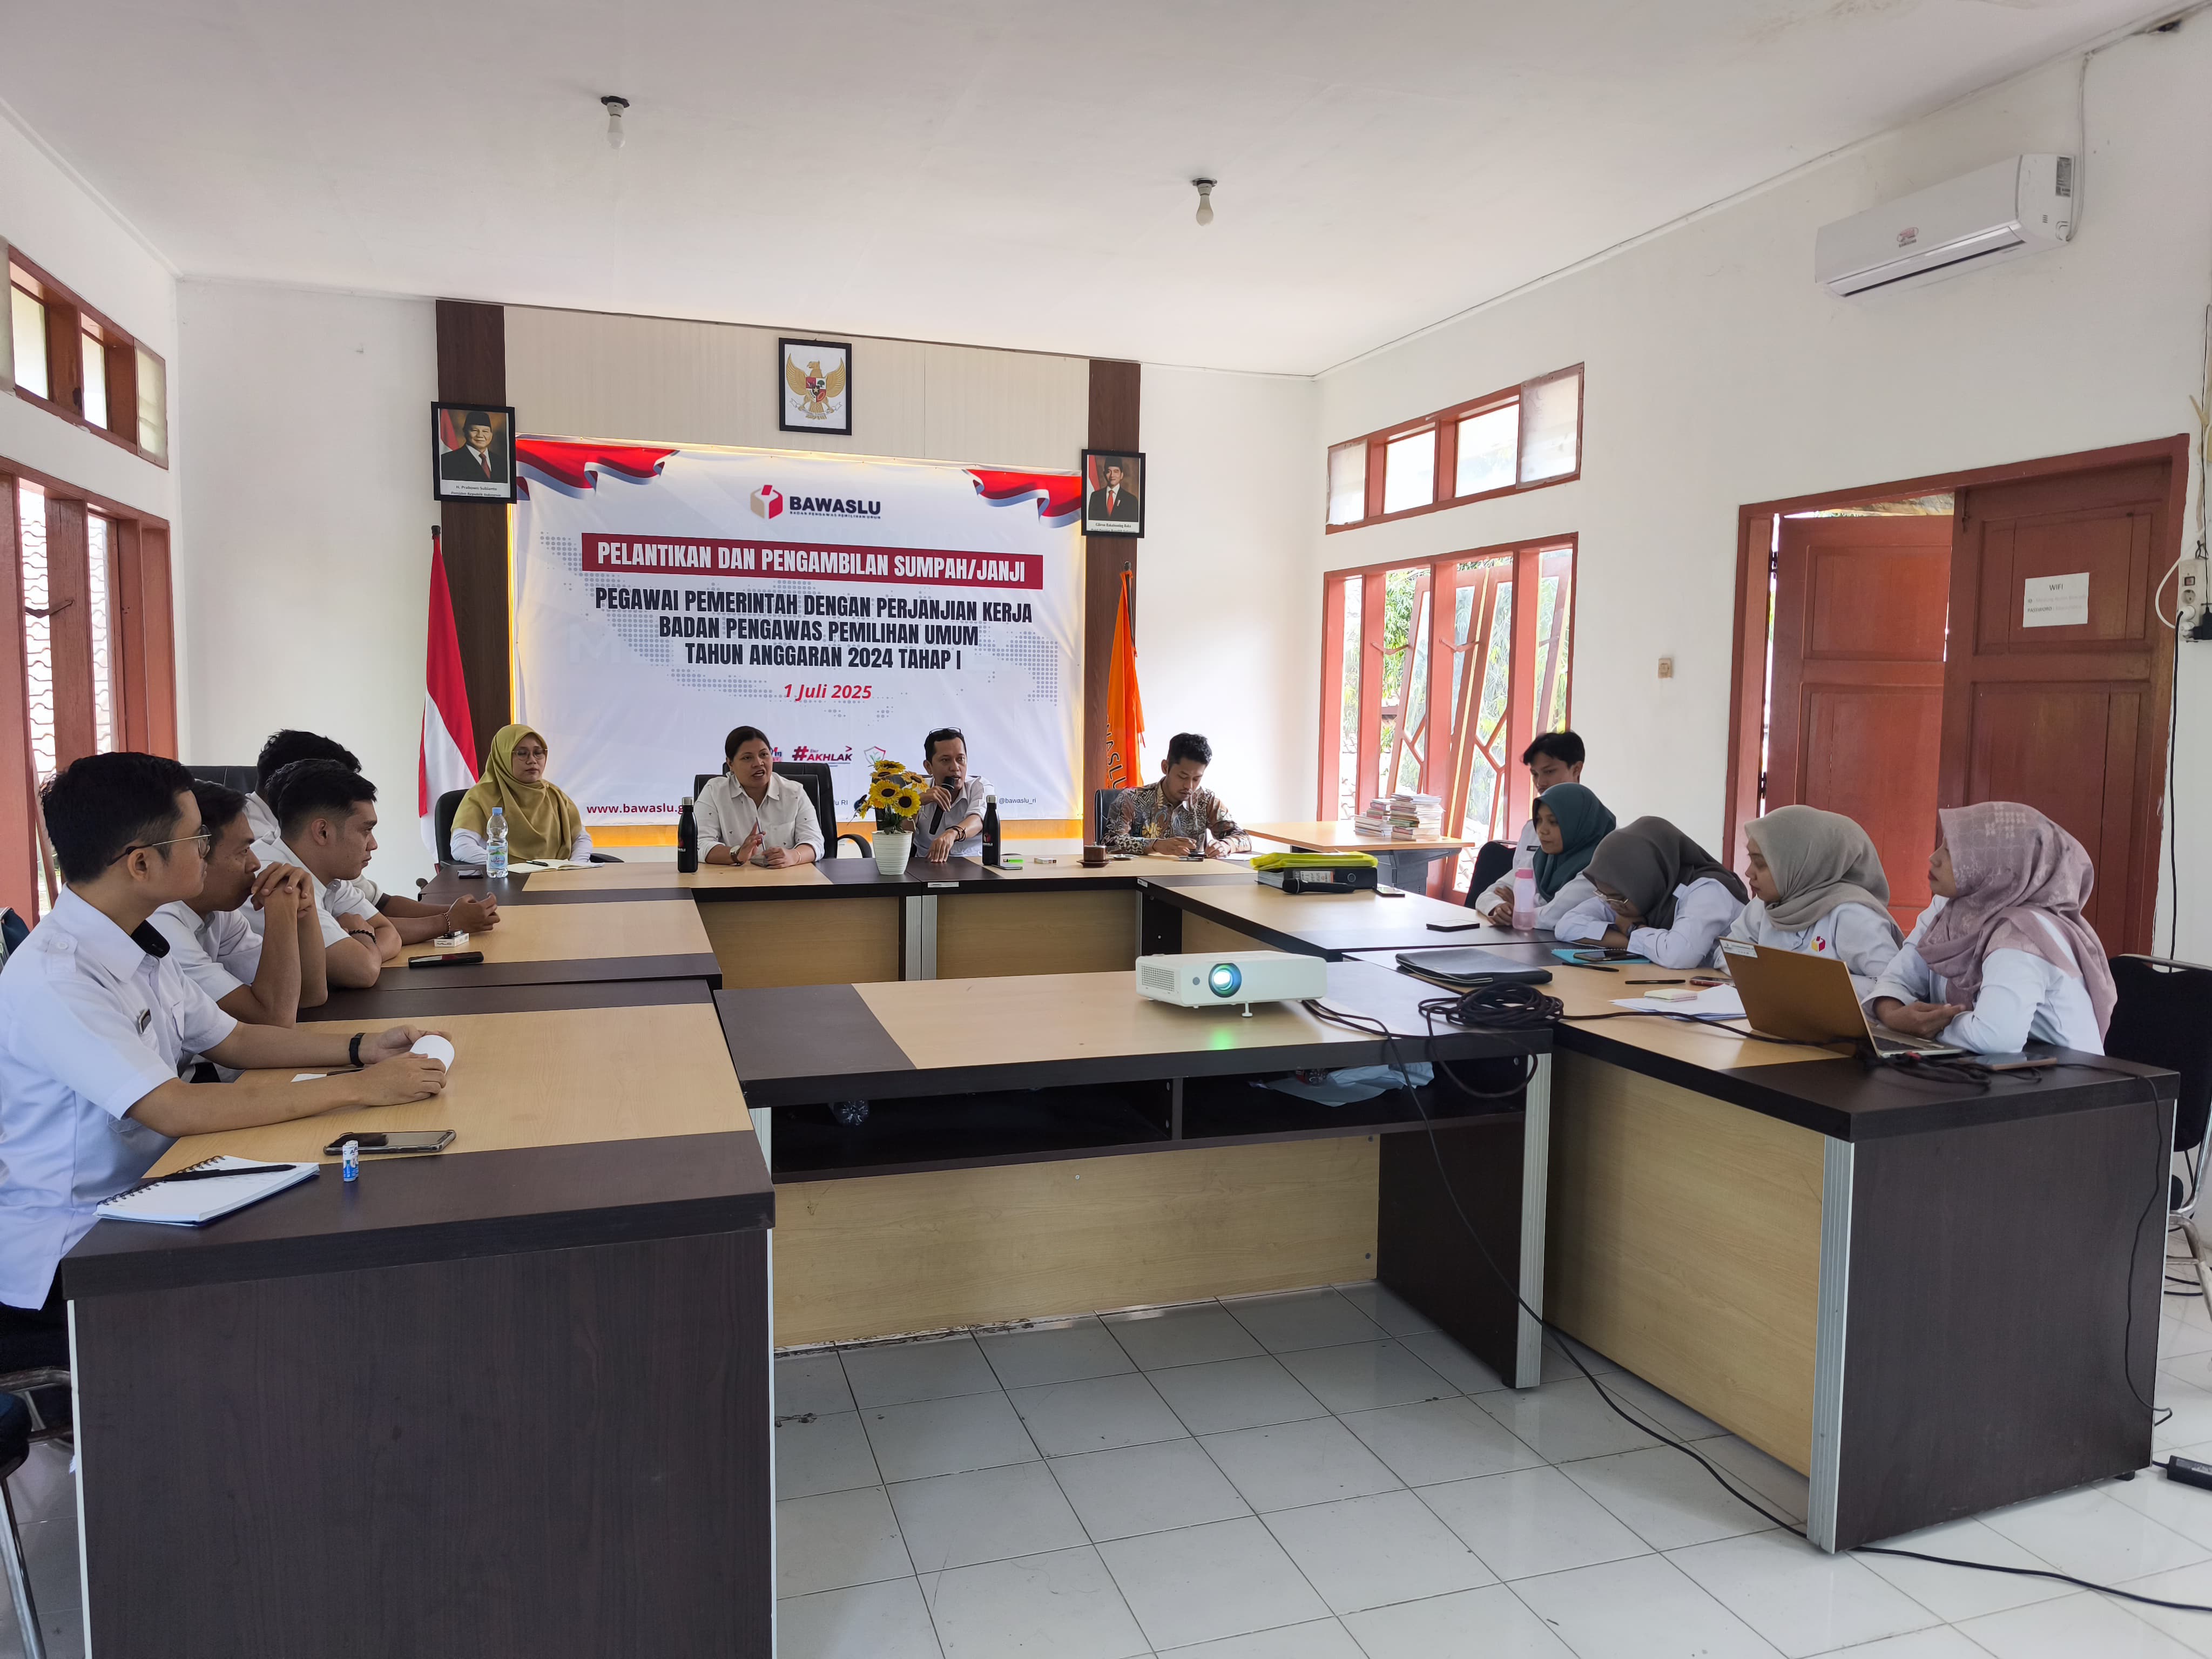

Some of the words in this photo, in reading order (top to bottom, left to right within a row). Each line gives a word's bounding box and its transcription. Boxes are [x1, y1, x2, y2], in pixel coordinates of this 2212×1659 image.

[790, 496, 881, 515] BAWASLU
[598, 542, 711, 568] PELANTIKAN
[718, 547, 755, 570] DAN
[761, 549, 888, 576] PENGAMBILAN
[894, 555, 1025, 582] SUMPAH/JANJI
[596, 588, 678, 611] PEGAWAI
[685, 591, 798, 615] PEMERINTAH
[804, 595, 870, 617] DENGAN
[877, 597, 977, 621] PERJANJIAN
[983, 602, 1032, 623] KERJA
[659, 616, 719, 638] BADAN
[726, 618, 822, 642] PENGAWAS
[829, 621, 919, 644] PEMILIHAN
[925, 625, 979, 646] UMUM
[685, 643, 743, 665] TAHUN
[750, 644, 842, 667] ANGGARAN
[848, 648, 893, 669] 2024
[898, 649, 951, 670] TAHAP
[956, 650, 961, 670] I
[784, 684, 792, 698] 1
[795, 684, 827, 702] Juli
[831, 685, 872, 699] 2025
